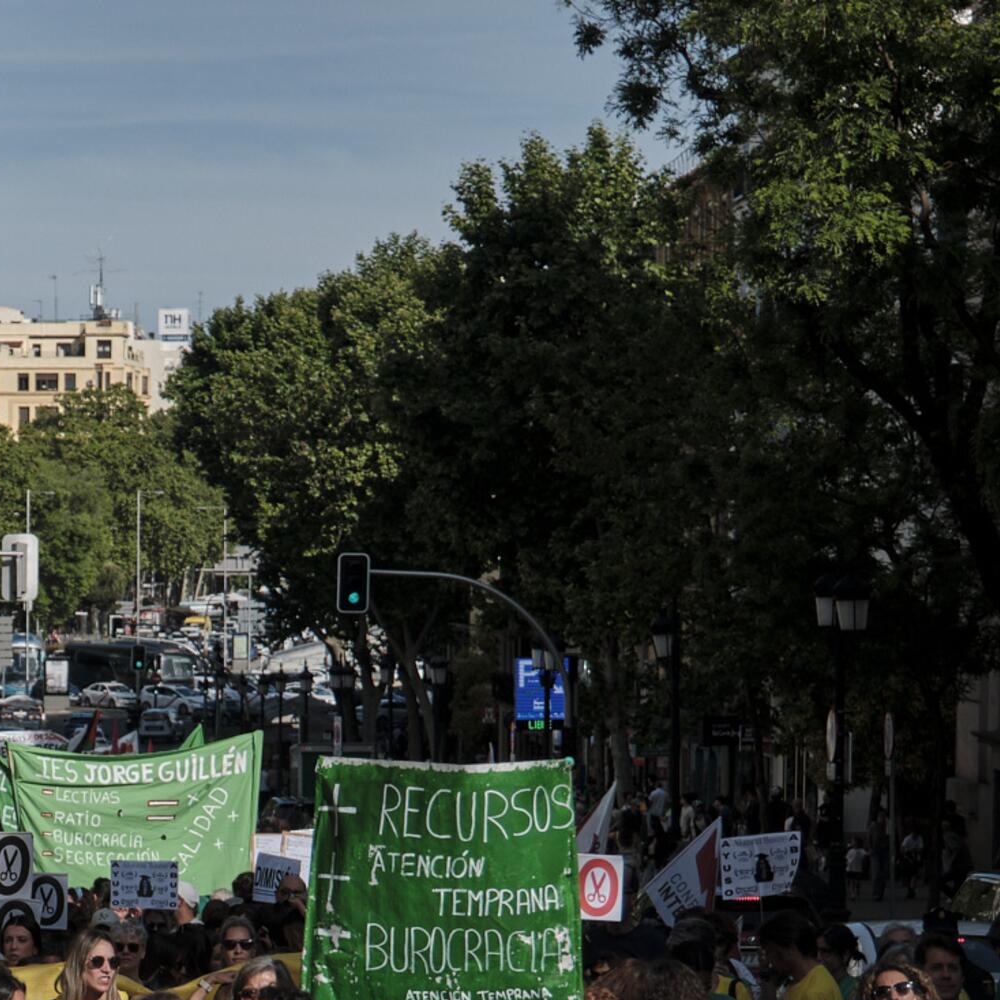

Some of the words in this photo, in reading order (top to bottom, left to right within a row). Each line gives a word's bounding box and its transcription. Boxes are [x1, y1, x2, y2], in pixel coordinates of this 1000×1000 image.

[36, 755, 79, 783] IES
[83, 762, 155, 785] JORGE
[158, 746, 249, 780] GUILLÉN
[55, 786, 121, 804] LECTIVAS
[379, 783, 575, 843] RECURSOS
[54, 810, 102, 828] RATIO
[371, 850, 486, 886] ATENCIÓN
[721, 840, 734, 897] AYUSO
[432, 884, 560, 917] TEMPRANA
